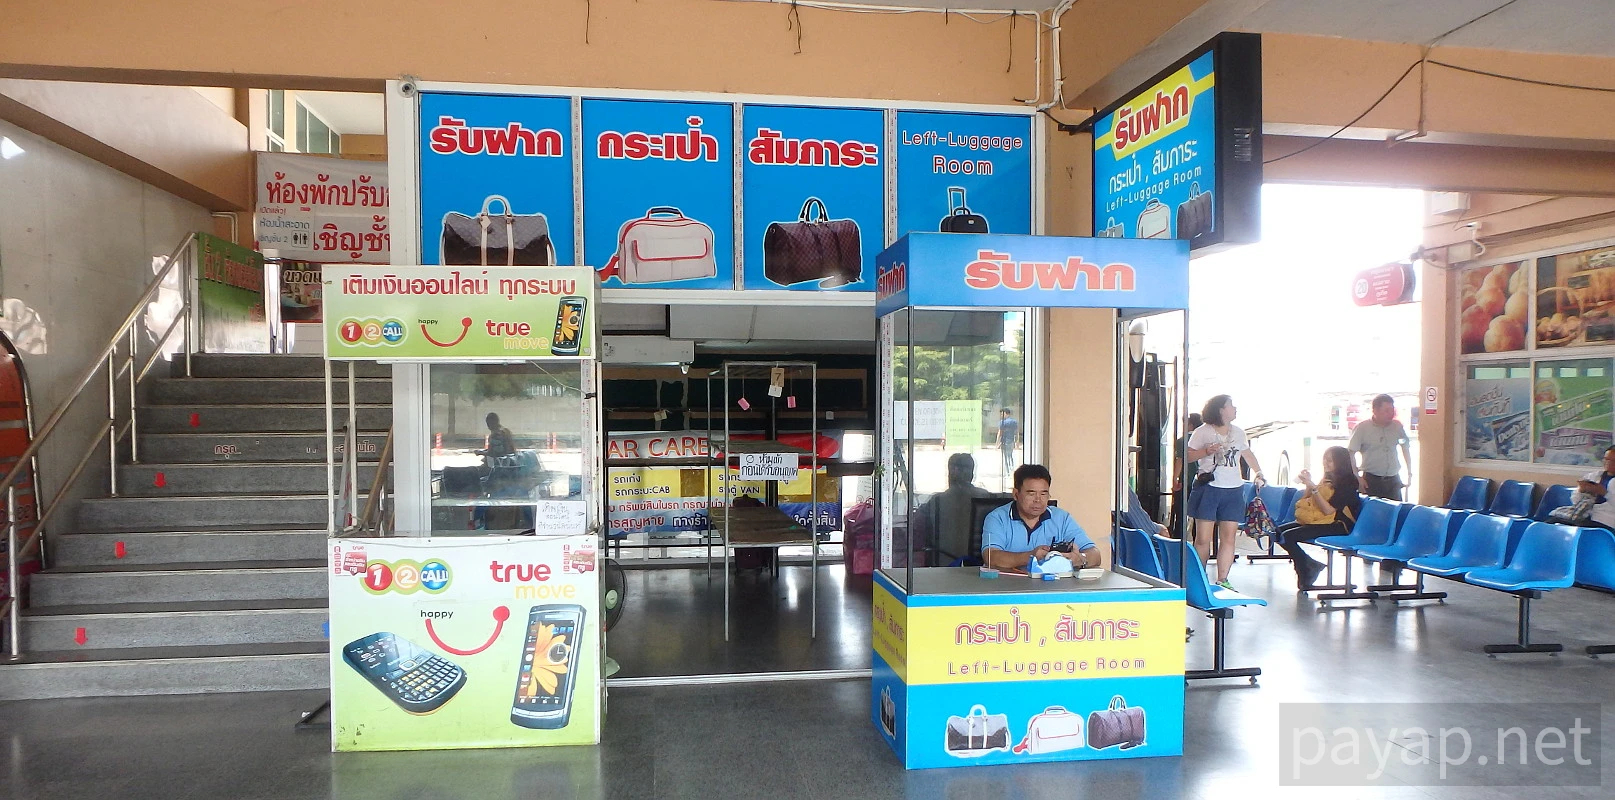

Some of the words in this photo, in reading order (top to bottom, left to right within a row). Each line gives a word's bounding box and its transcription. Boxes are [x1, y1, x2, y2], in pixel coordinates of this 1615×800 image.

[1115, 85, 1190, 151] รับฝาก
[430, 115, 564, 157] รับฝาก
[597, 115, 719, 162] กระเป๋า
[749, 128, 879, 168] สัมภาระ
[902, 130, 1023, 151] Left-Luggage
[933, 155, 993, 175] Room
[1104, 153, 1142, 195] กระเป๋า
[1152, 139, 1198, 175] สัมภาระ
[266, 171, 389, 208] ห้องพักปรับ
[1106, 180, 1170, 213] Left-Luggage
[1173, 166, 1202, 186] Room
[313, 214, 390, 259] เชิญชั้
[964, 248, 1137, 292] รับฝาก
[342, 270, 490, 296] เติมเงินออนไลน์
[498, 277, 576, 301] ทุกระบบ
[347, 325, 355, 339] 1
[485, 319, 531, 336] true
[503, 336, 550, 350] move
[608, 439, 640, 458] AR
[648, 436, 709, 457] CARE
[373, 568, 383, 587] 1
[489, 560, 552, 582] true
[515, 584, 576, 599] move
[420, 609, 454, 619] happy
[955, 606, 1031, 646] กระเป๋า
[1054, 614, 1141, 644] สัมภาระ
[947, 659, 1089, 676] Left-Luggage
[1096, 656, 1147, 670] Room
